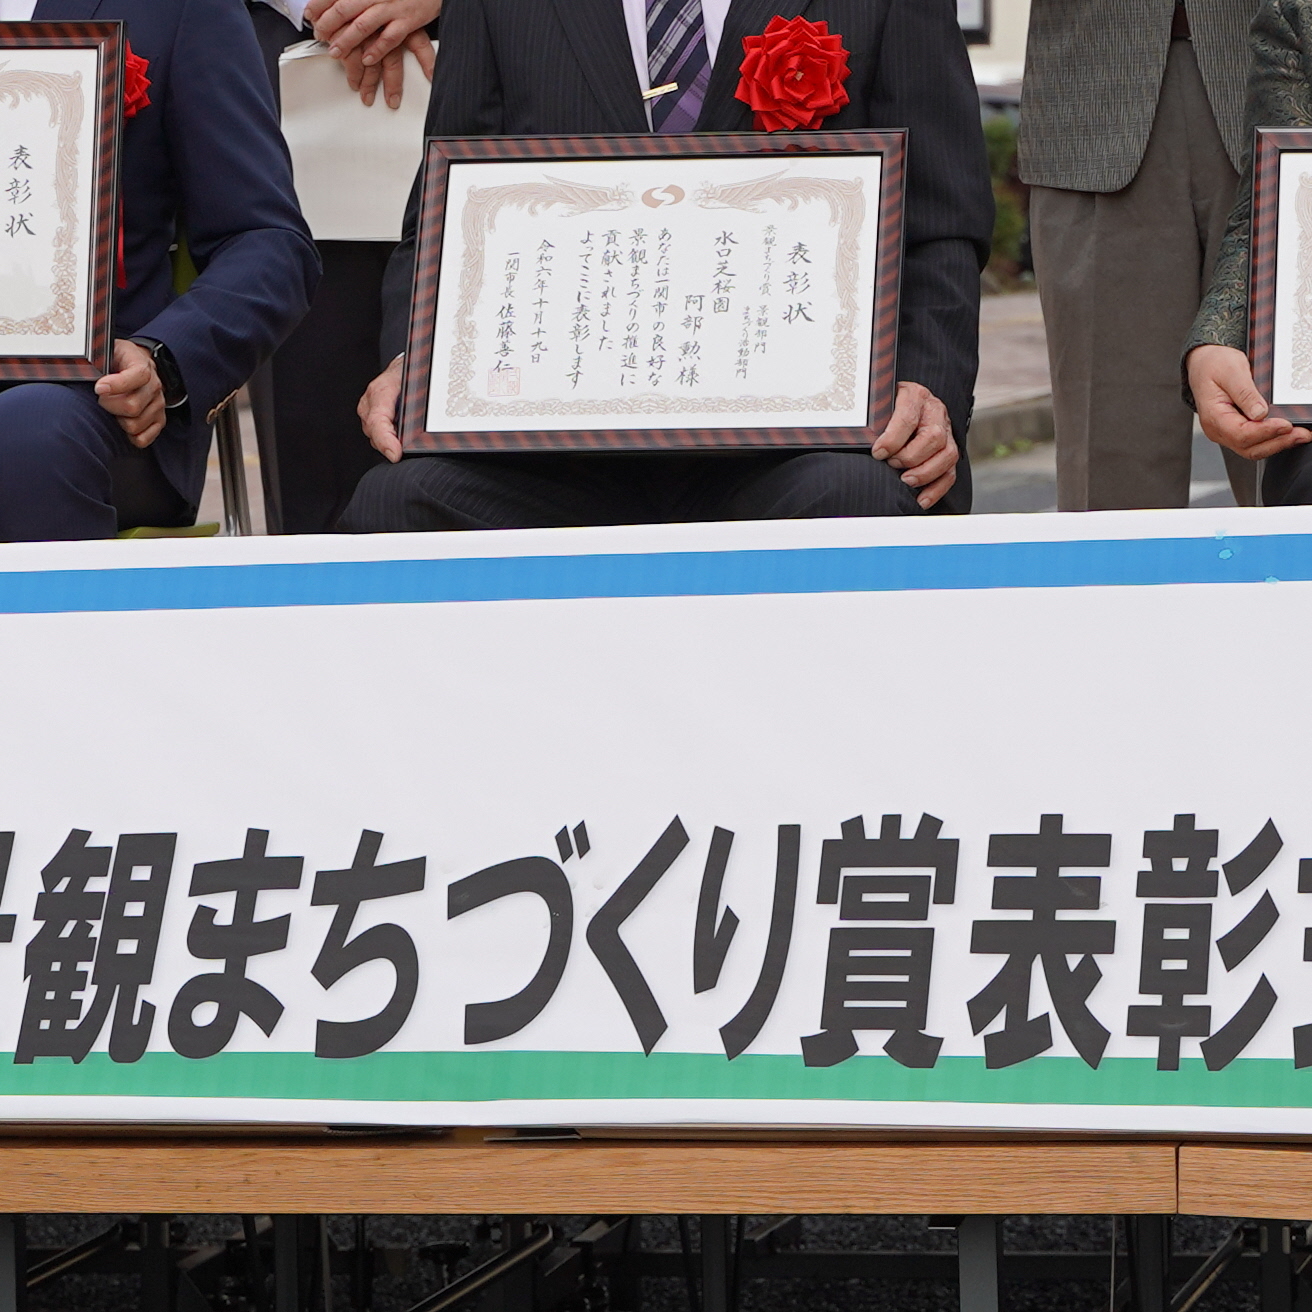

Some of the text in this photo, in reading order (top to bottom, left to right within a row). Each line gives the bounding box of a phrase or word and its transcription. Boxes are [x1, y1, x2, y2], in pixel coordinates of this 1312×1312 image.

[5, 144, 36, 237] 表彰状
[531, 239, 554, 363] 令和六年十月十九日
[565, 230, 593, 388] よってここに表彰します
[599, 229, 622, 350] 貢献されました
[620, 228, 647, 385] 景観まちづくりの推進に
[710, 230, 738, 313] 水口芝桜園
[782, 241, 814, 324] 表彰状
